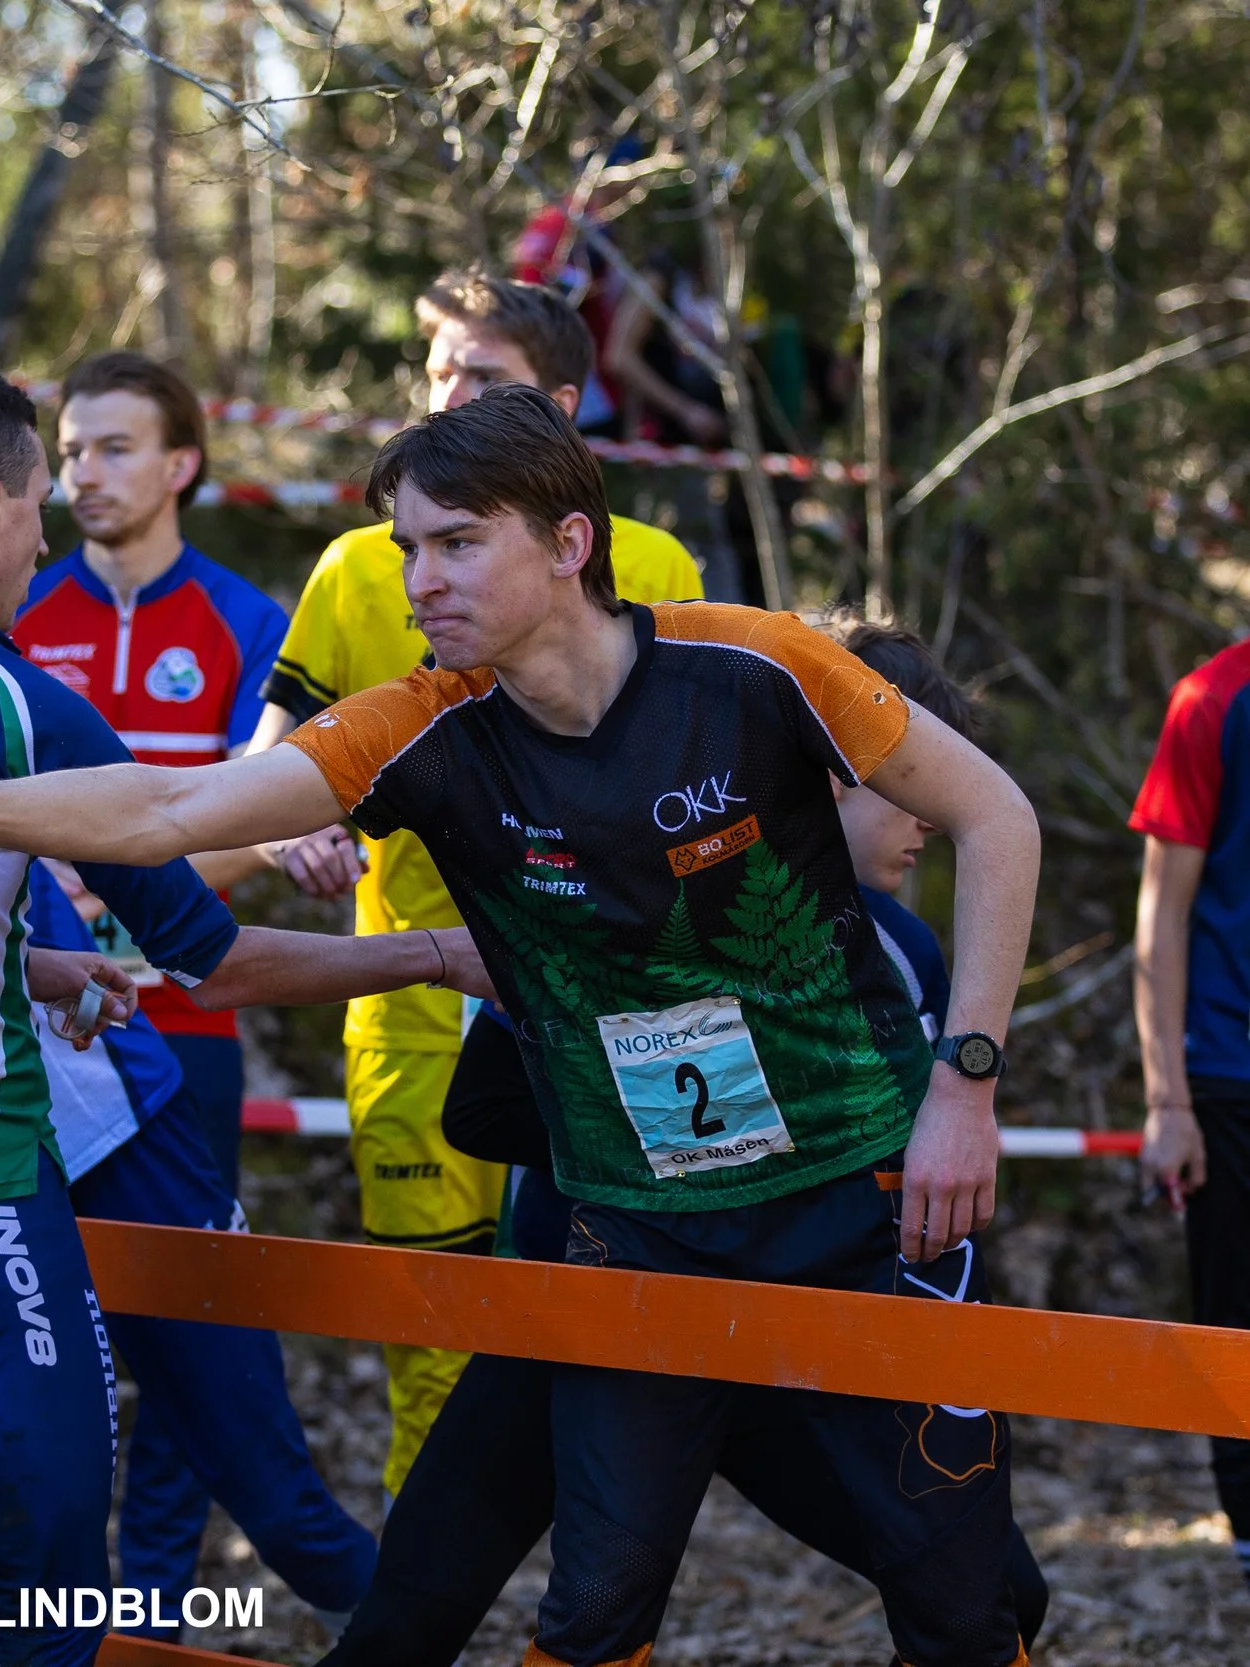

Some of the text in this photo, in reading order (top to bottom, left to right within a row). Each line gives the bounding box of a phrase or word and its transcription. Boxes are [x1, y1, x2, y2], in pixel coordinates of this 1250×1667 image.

[653, 770, 747, 833] OKK
[697, 821, 754, 857] BOLIST
[523, 875, 586, 896] TRIMTEX
[615, 1025, 699, 1056] NOREX
[674, 1062, 727, 1139] 2
[671, 1138, 770, 1165] OK Måsen
[84, 1288, 118, 1496] nona
